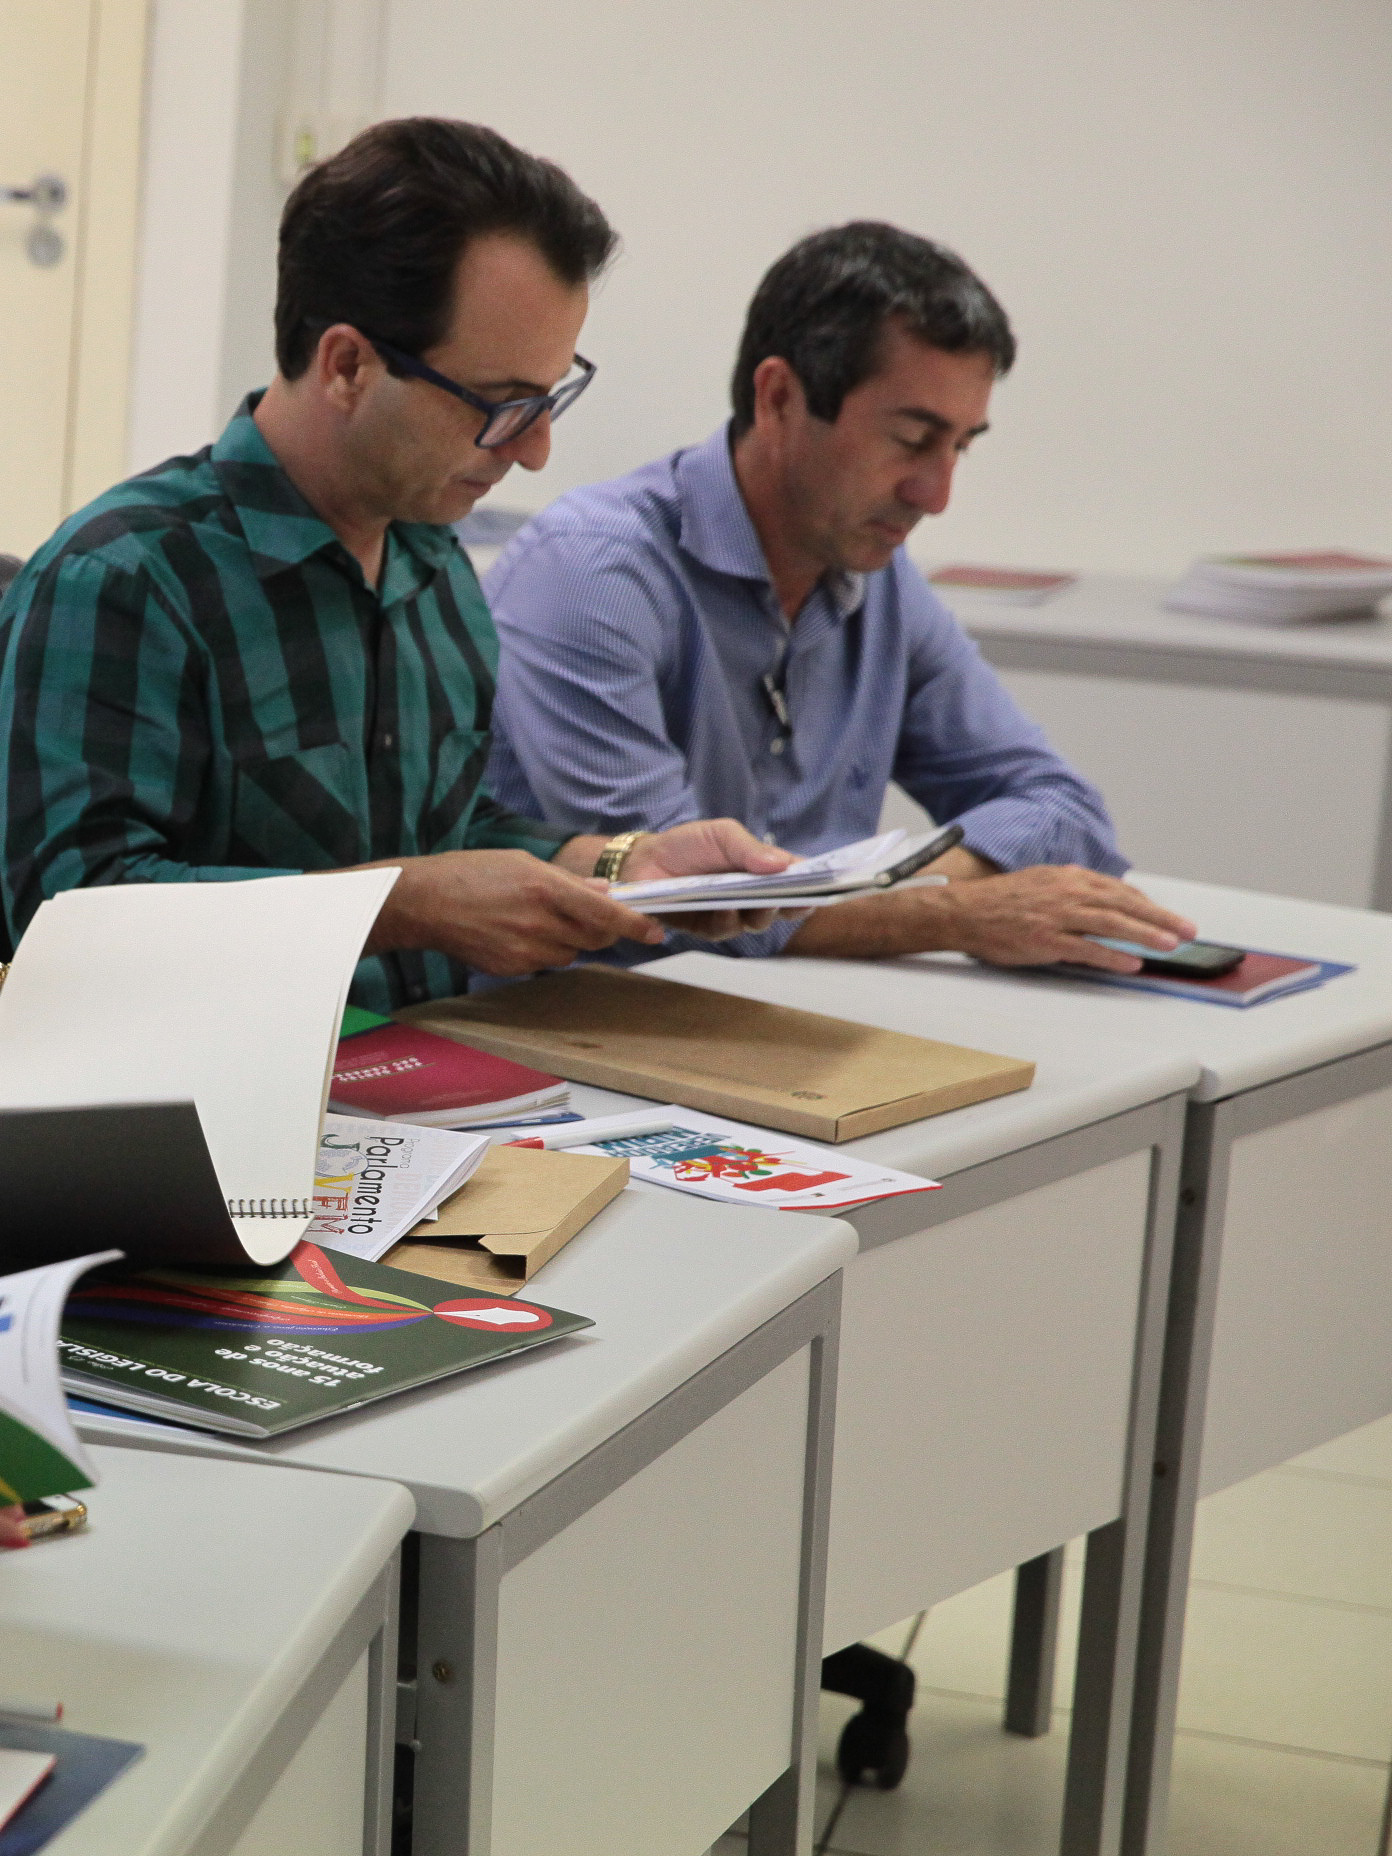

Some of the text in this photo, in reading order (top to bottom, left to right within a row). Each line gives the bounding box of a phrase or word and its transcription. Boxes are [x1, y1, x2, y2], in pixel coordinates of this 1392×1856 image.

[399, 1137, 421, 1170] Programa
[347, 1135, 405, 1235] Parlamento
[214, 1347, 342, 1388] 15 anos de
[244, 1343, 366, 1379] atuação e
[266, 1338, 385, 1374] formação
[145, 1367, 187, 1383] DO
[187, 1377, 282, 1411] ESCOLA
